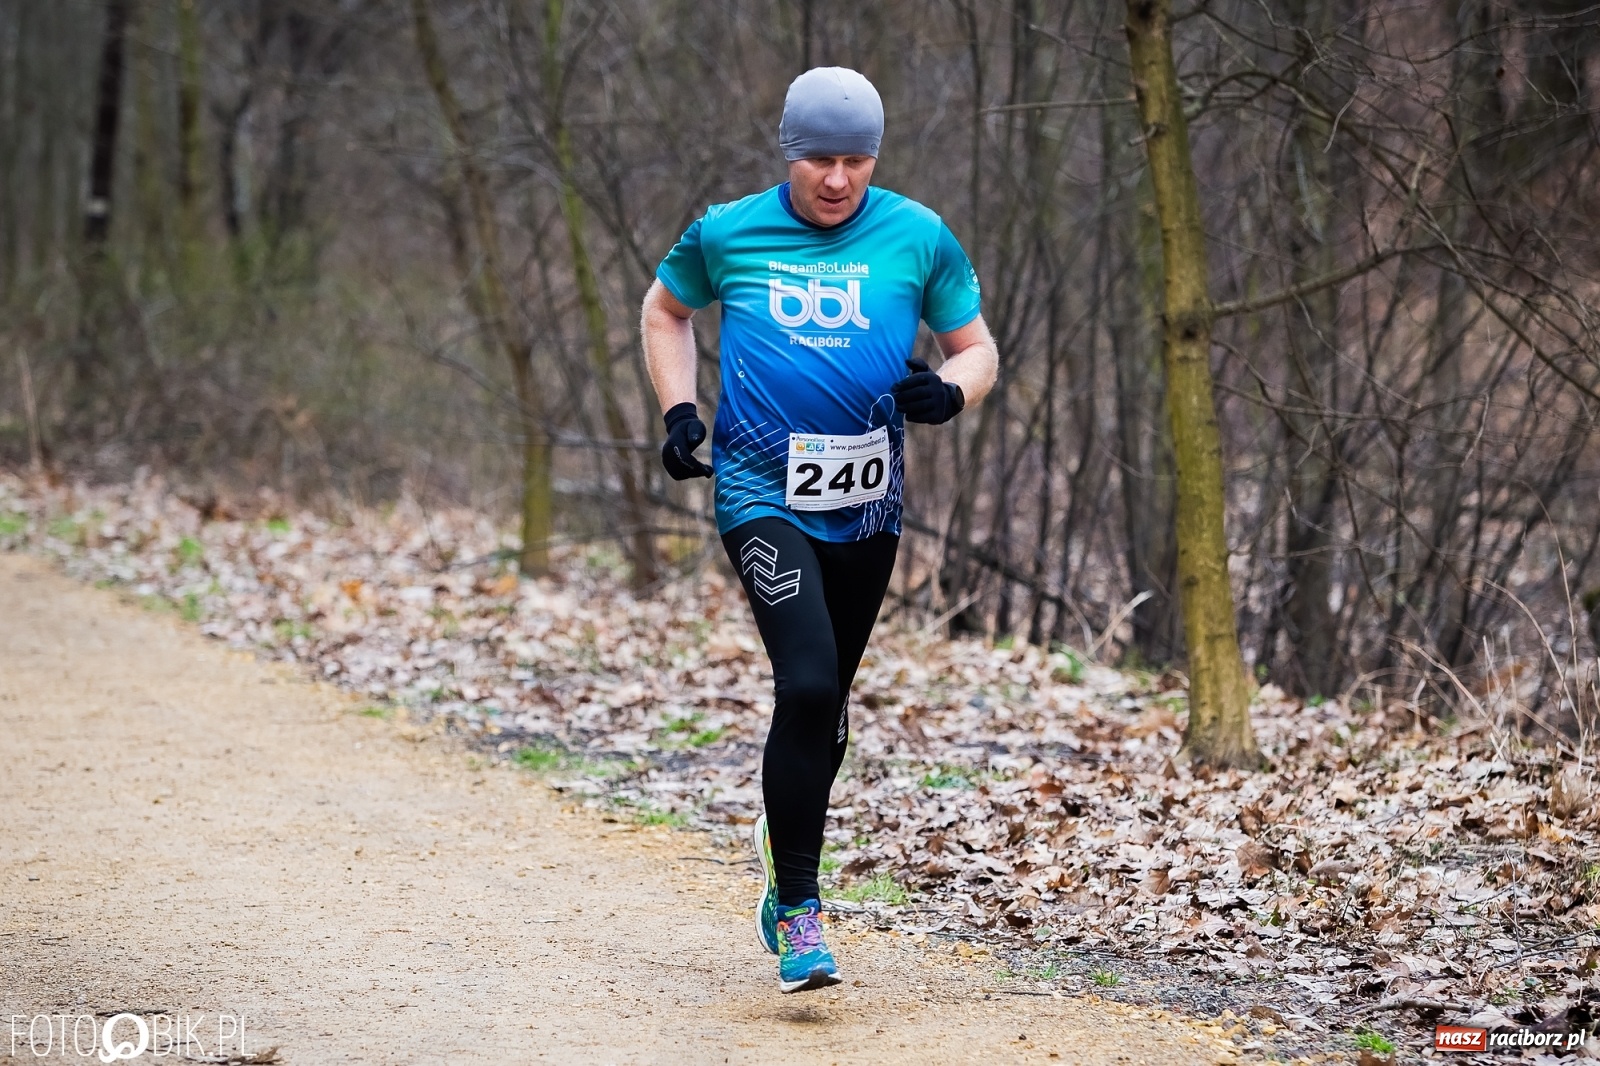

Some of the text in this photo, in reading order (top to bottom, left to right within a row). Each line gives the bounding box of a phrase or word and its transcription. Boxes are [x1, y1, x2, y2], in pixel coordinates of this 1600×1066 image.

[768, 261, 869, 275] BiegamBoLubię
[768, 278, 870, 330] bbl
[789, 335, 851, 348] RACIBÓRZ
[830, 435, 886, 451] www.personalbest.pl
[793, 457, 884, 496] 240
